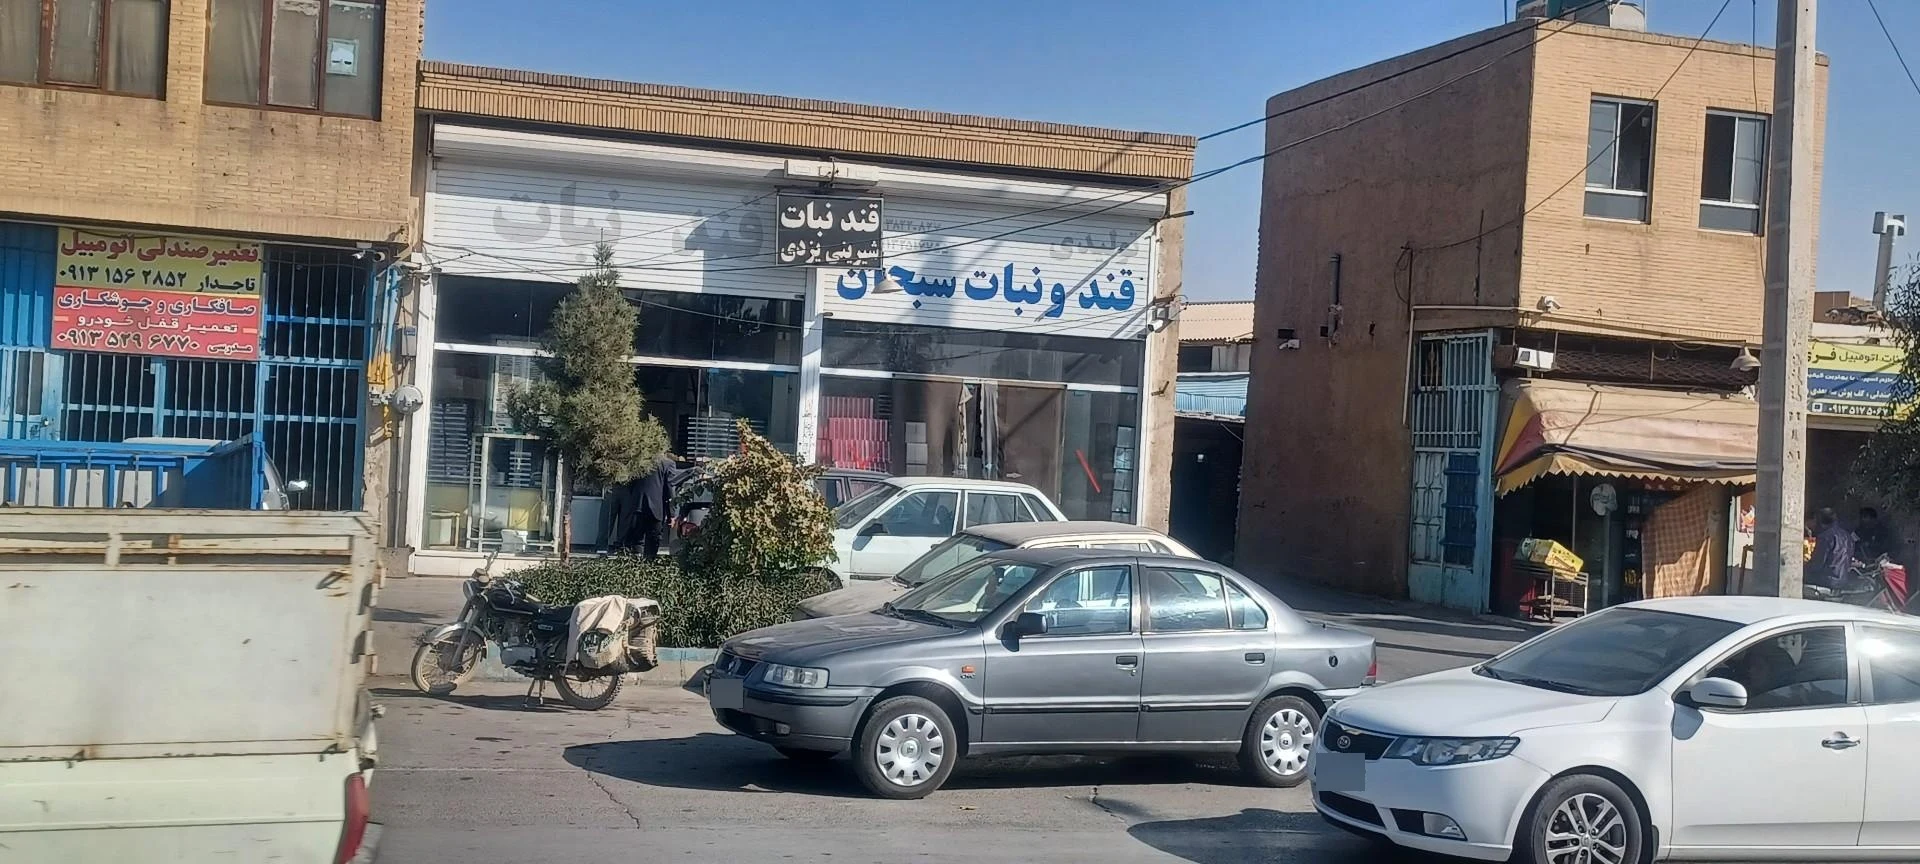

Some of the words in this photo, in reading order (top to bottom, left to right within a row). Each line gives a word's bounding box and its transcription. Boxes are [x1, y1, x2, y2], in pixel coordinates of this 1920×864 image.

[780, 201, 834, 237] نبات
[840, 203, 880, 232] قند
[137, 236, 208, 262] صندلی
[206, 243, 260, 266] تعمیر
[780, 240, 821, 263] یزدی
[825, 240, 880, 266] شیرینی
[59, 264, 99, 282] ۰۹۱۳
[105, 266, 136, 284] ۱۵۶
[142, 269, 187, 288] ۲۸۵۲
[197, 275, 256, 293] تاجدار
[836, 264, 957, 309] سبحان
[964, 263, 1043, 315] نبات
[1079, 268, 1136, 311] قند
[58, 289, 153, 314] جوشکاری
[156, 299, 166, 315] و
[169, 294, 256, 316] صافکاری
[1044, 282, 1066, 318] و
[77, 314, 134, 328] خودرو
[138, 317, 179, 331] قفل
[183, 322, 239, 335] تعمیر
[57, 328, 104, 346] ۰۹۱۳
[105, 330, 143, 348] ۵۲۹
[148, 333, 200, 352] ۶۷۷۰
[207, 341, 253, 355] مدرسی
[1838, 350, 1879, 364] اتومبیل
